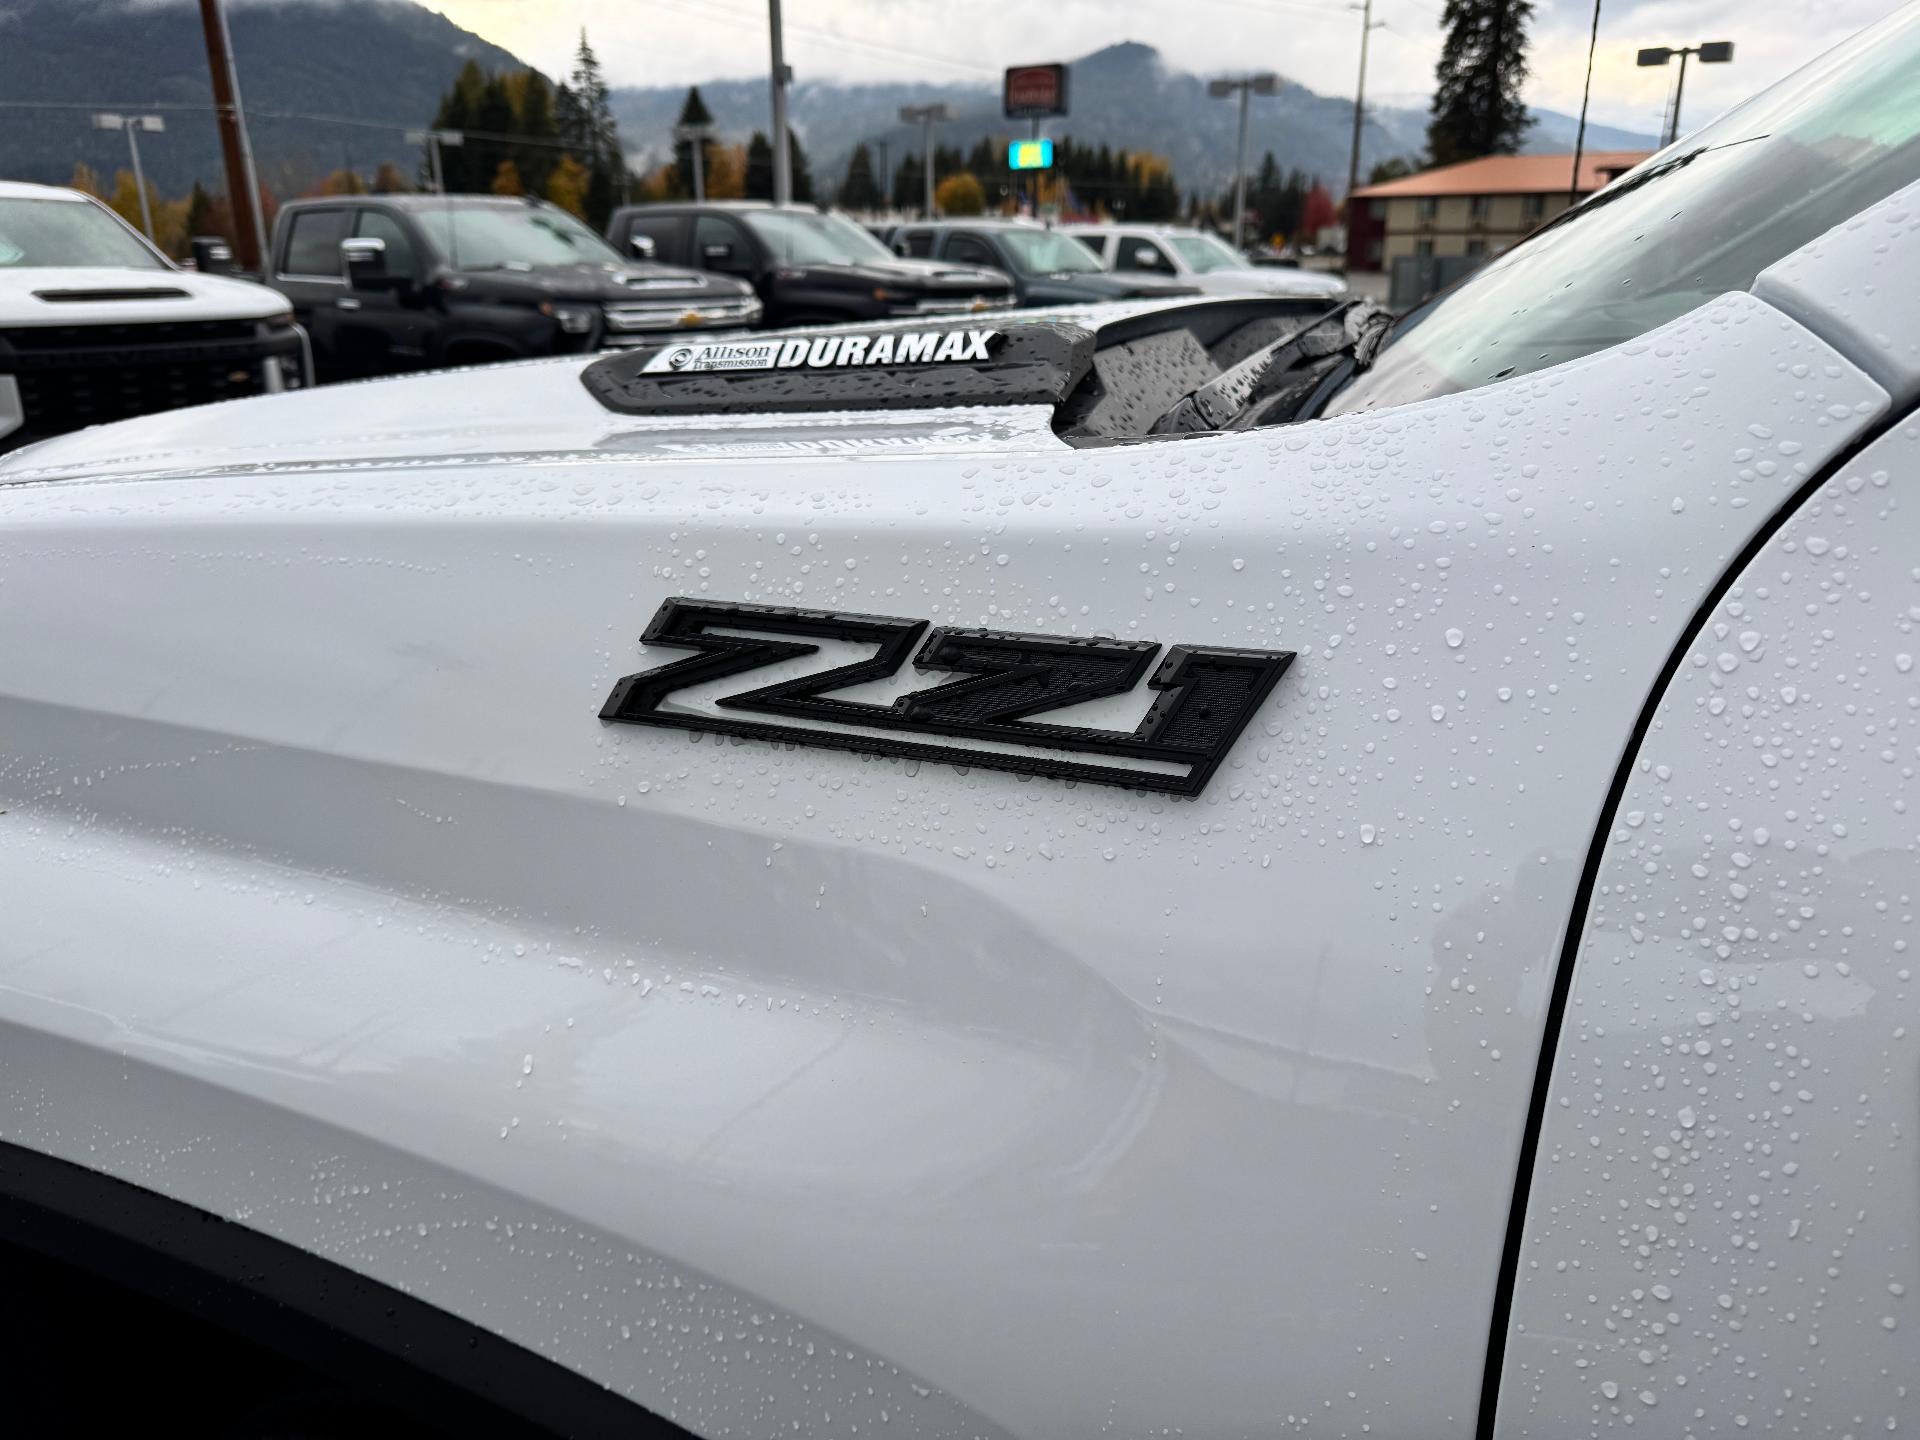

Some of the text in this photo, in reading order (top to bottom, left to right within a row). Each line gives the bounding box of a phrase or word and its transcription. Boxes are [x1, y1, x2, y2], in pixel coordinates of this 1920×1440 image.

[695, 346, 771, 360] Allison
[777, 330, 999, 368] DURAMAX
[693, 358, 769, 372] Transmission
